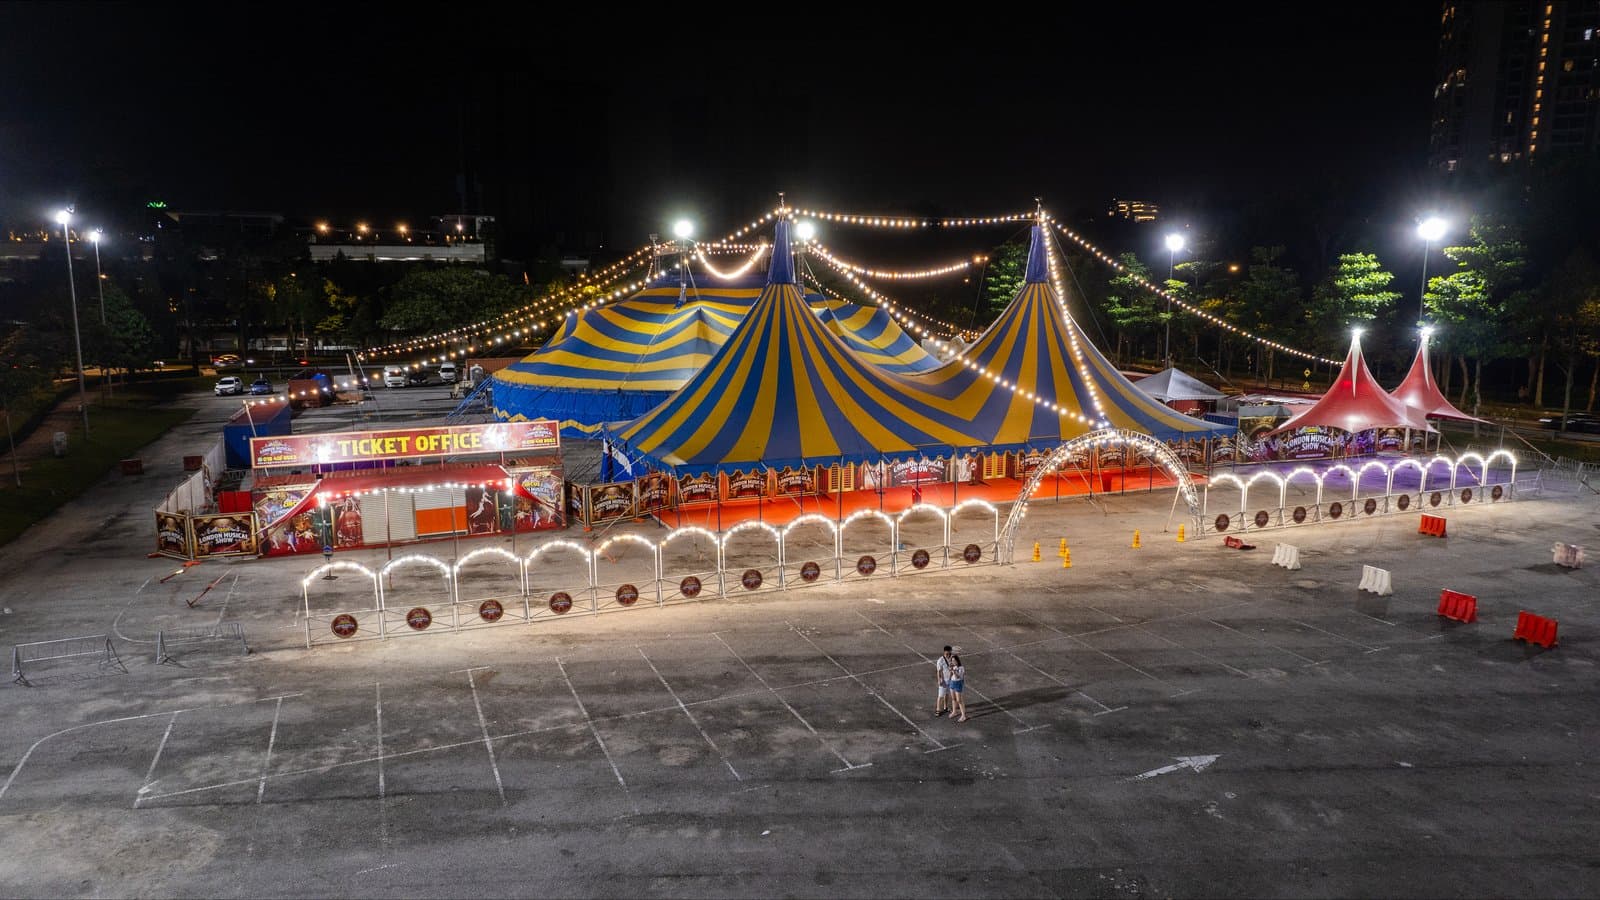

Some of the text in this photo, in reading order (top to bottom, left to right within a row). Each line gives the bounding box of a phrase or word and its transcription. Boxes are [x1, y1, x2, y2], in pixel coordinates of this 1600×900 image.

[337, 432, 483, 457] TICKET OFFICE
[1287, 435, 1310, 448] LONDON
[1301, 442, 1319, 451] SHOW
[199, 532, 248, 544] LONDON MUSICAL
